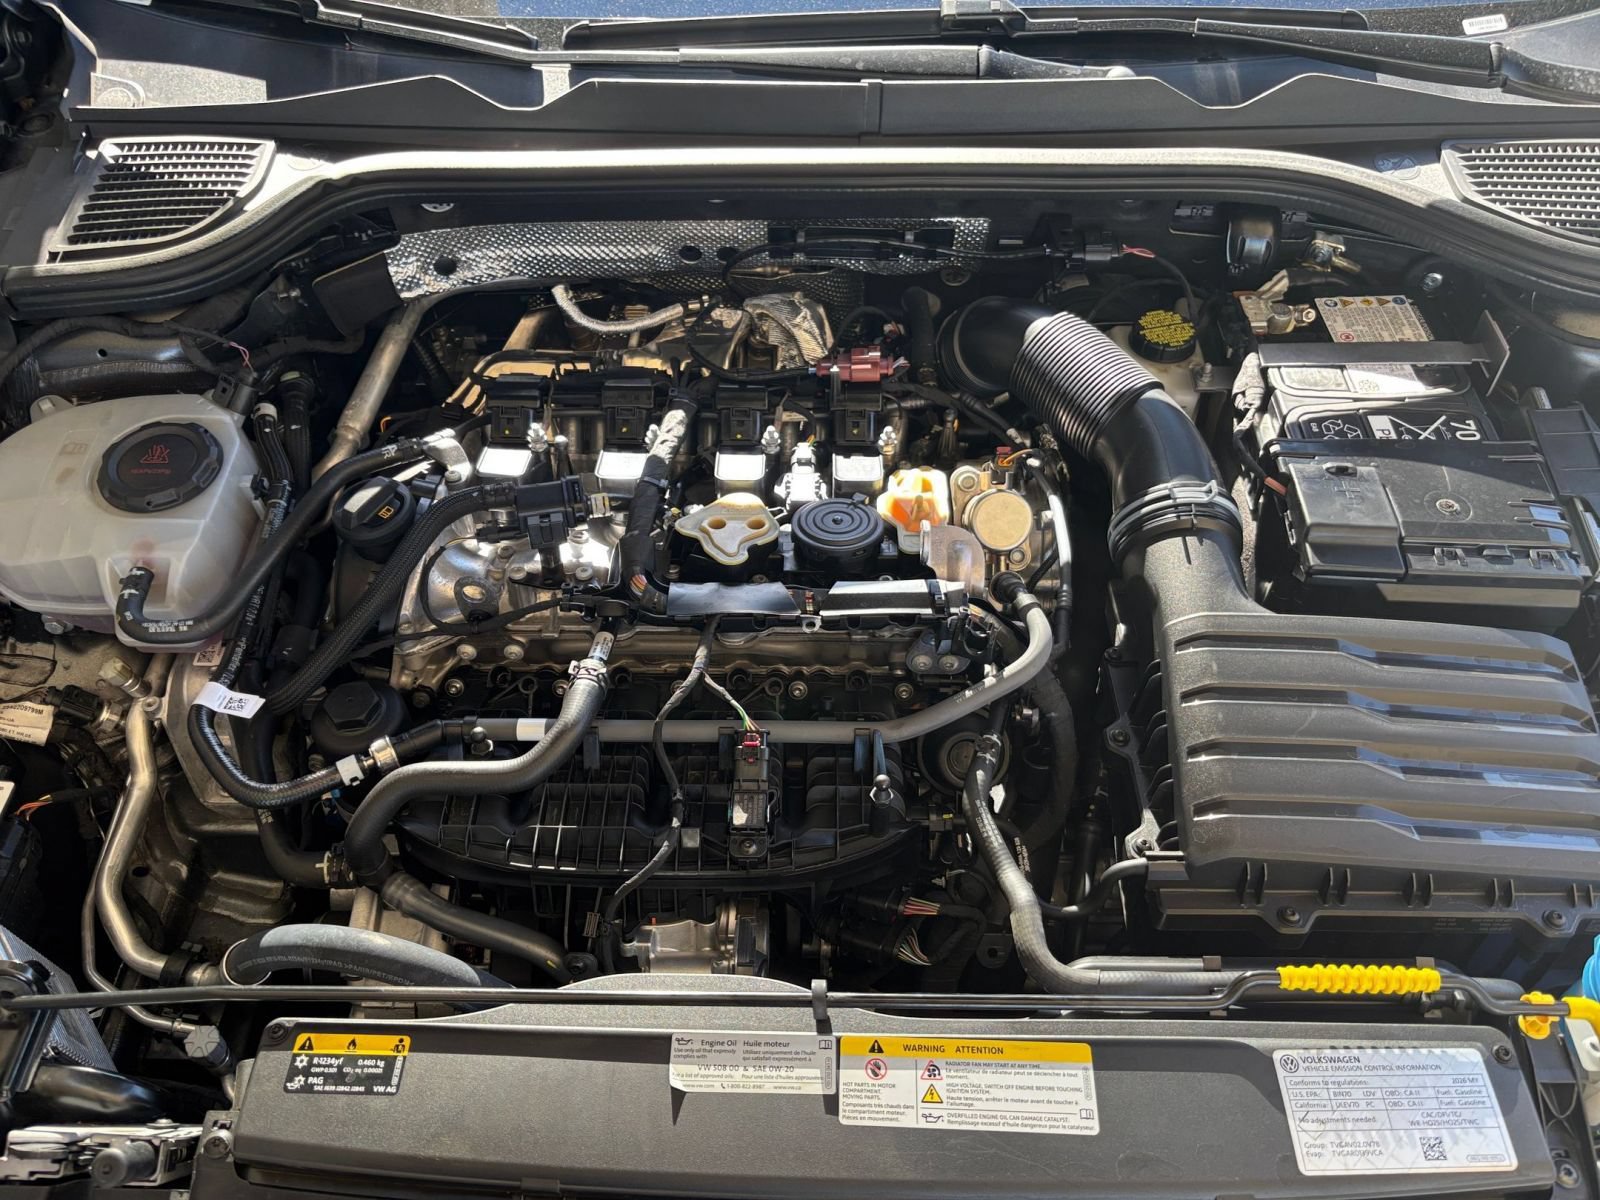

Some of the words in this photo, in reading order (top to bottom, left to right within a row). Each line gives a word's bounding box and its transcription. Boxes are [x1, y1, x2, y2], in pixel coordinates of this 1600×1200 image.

[700, 1040, 725, 1048] Engine
[902, 1044, 946, 1054] WARNING
[955, 1046, 1004, 1055] ATTENTION
[376, 1059, 385, 1068] kg
[1300, 1056, 1360, 1064] VOLKSWAGEN
[712, 1064, 727, 1072] 508
[728, 1064, 740, 1072] 00
[308, 1076, 324, 1084] PAG
